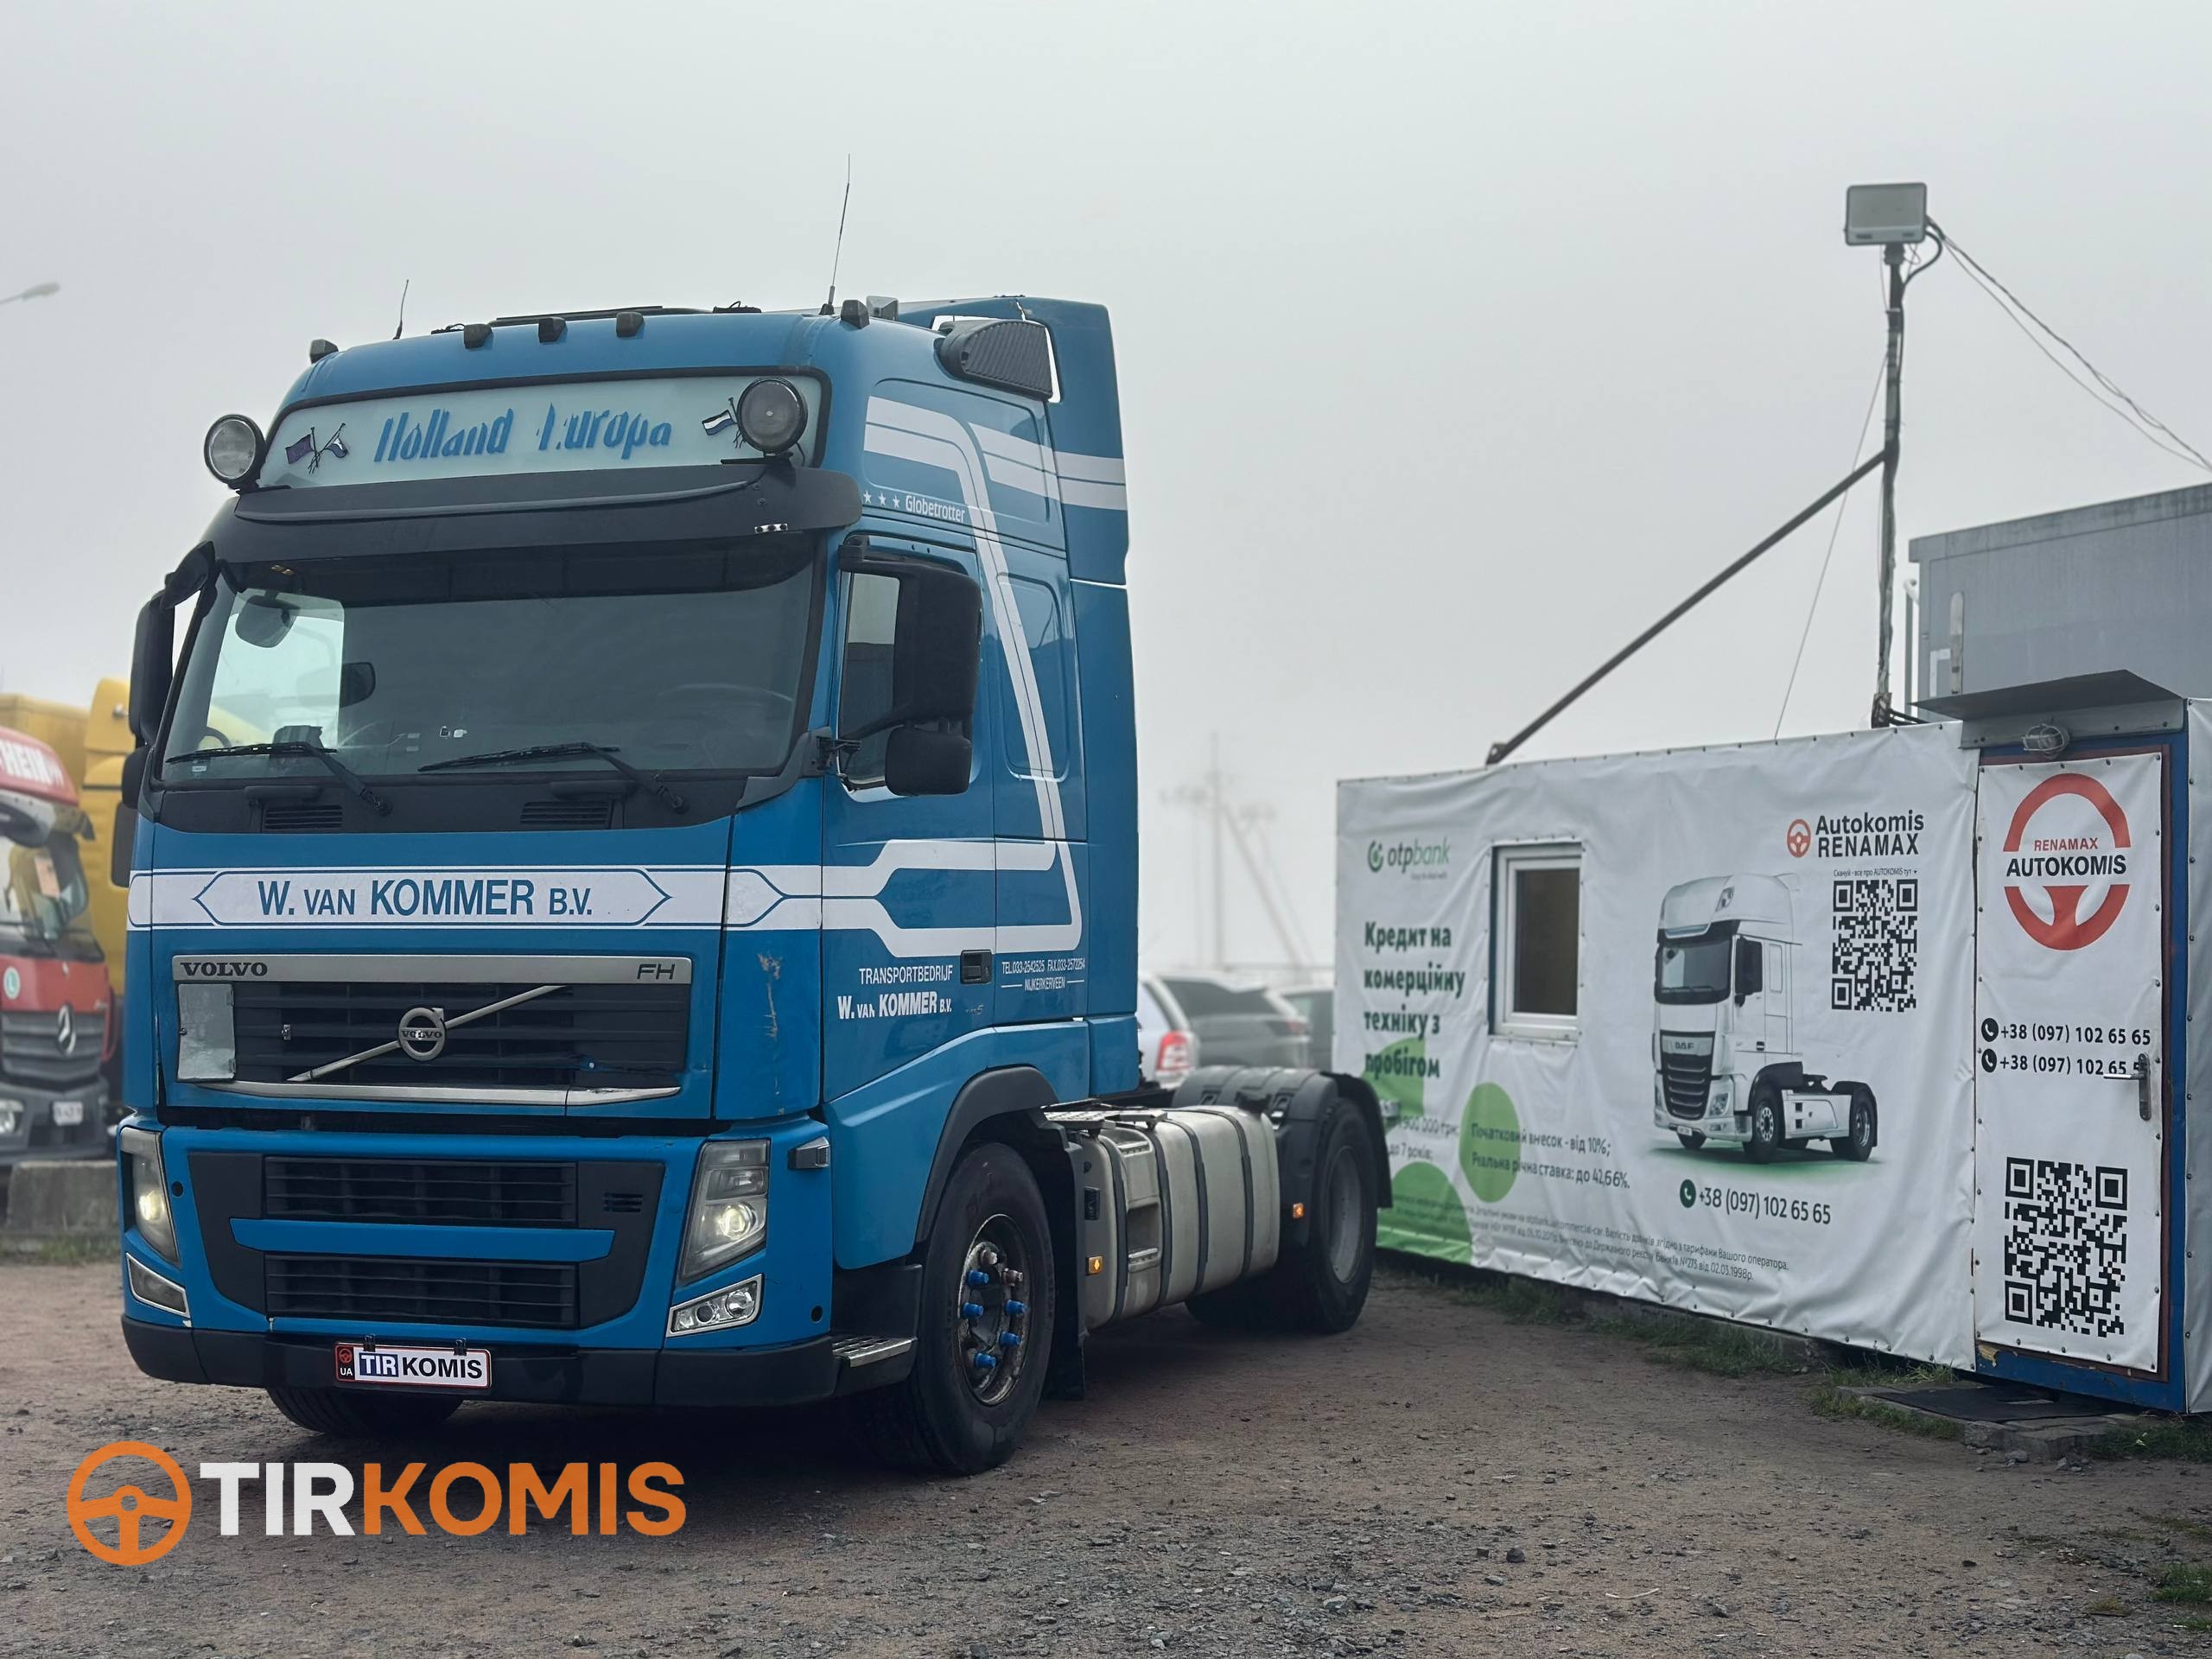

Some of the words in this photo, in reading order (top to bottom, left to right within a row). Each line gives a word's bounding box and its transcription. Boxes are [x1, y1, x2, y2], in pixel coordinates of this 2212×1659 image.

[906, 495, 965, 523] Globetrotter
[1815, 810, 1924, 835] Autokomis
[1388, 835, 1451, 874] otpbank
[1818, 833, 1918, 857] RENAMAX
[2034, 837, 2099, 852] RENAMAX
[2006, 855, 2126, 878] AUTOKOMIS
[259, 879, 295, 916] W.
[304, 889, 357, 916] VAN
[371, 878, 534, 916] KOMMER
[550, 888, 593, 916] B.V.
[1364, 921, 1427, 953] Кредит
[1431, 927, 1452, 947] на
[180, 962, 268, 978] VOLVO
[637, 963, 675, 980] FH
[859, 965, 953, 985] TRANSPORTBEDRIJF
[1363, 962, 1465, 999] комерційну
[837, 995, 855, 1019] W.
[879, 991, 938, 1017] KOMMER
[940, 998, 952, 1014] B.V.
[1363, 1004, 1428, 1040] техніку
[2001, 1024, 2027, 1039] +38
[2032, 1023, 2069, 1043] (097)
[2075, 1027, 2103, 1044] 102
[2108, 1028, 2126, 1045] 65
[2132, 1029, 2151, 1046] 65
[1365, 1048, 1440, 1079] пробігом
[1999, 1055, 2028, 1071] +38
[2032, 1055, 2071, 1075] (097)
[2076, 1058, 2104, 1075] 102
[2108, 1060, 2126, 1075] 65
[1471, 1122, 1527, 1143] Початковий
[1529, 1132, 1563, 1148] внесок
[1571, 1135, 1586, 1154] від
[1575, 1170, 1591, 1185] до
[1700, 1187, 1722, 1208] +38
[1726, 1188, 1760, 1219] (097)
[1764, 1196, 1788, 1218] 102
[1791, 1200, 1809, 1221] 65
[1813, 1203, 1831, 1225] 65
[1719, 1248, 1745, 1262] Вашого
[1746, 1255, 1789, 1272] оператора.
[340, 1367, 353, 1376] UA
